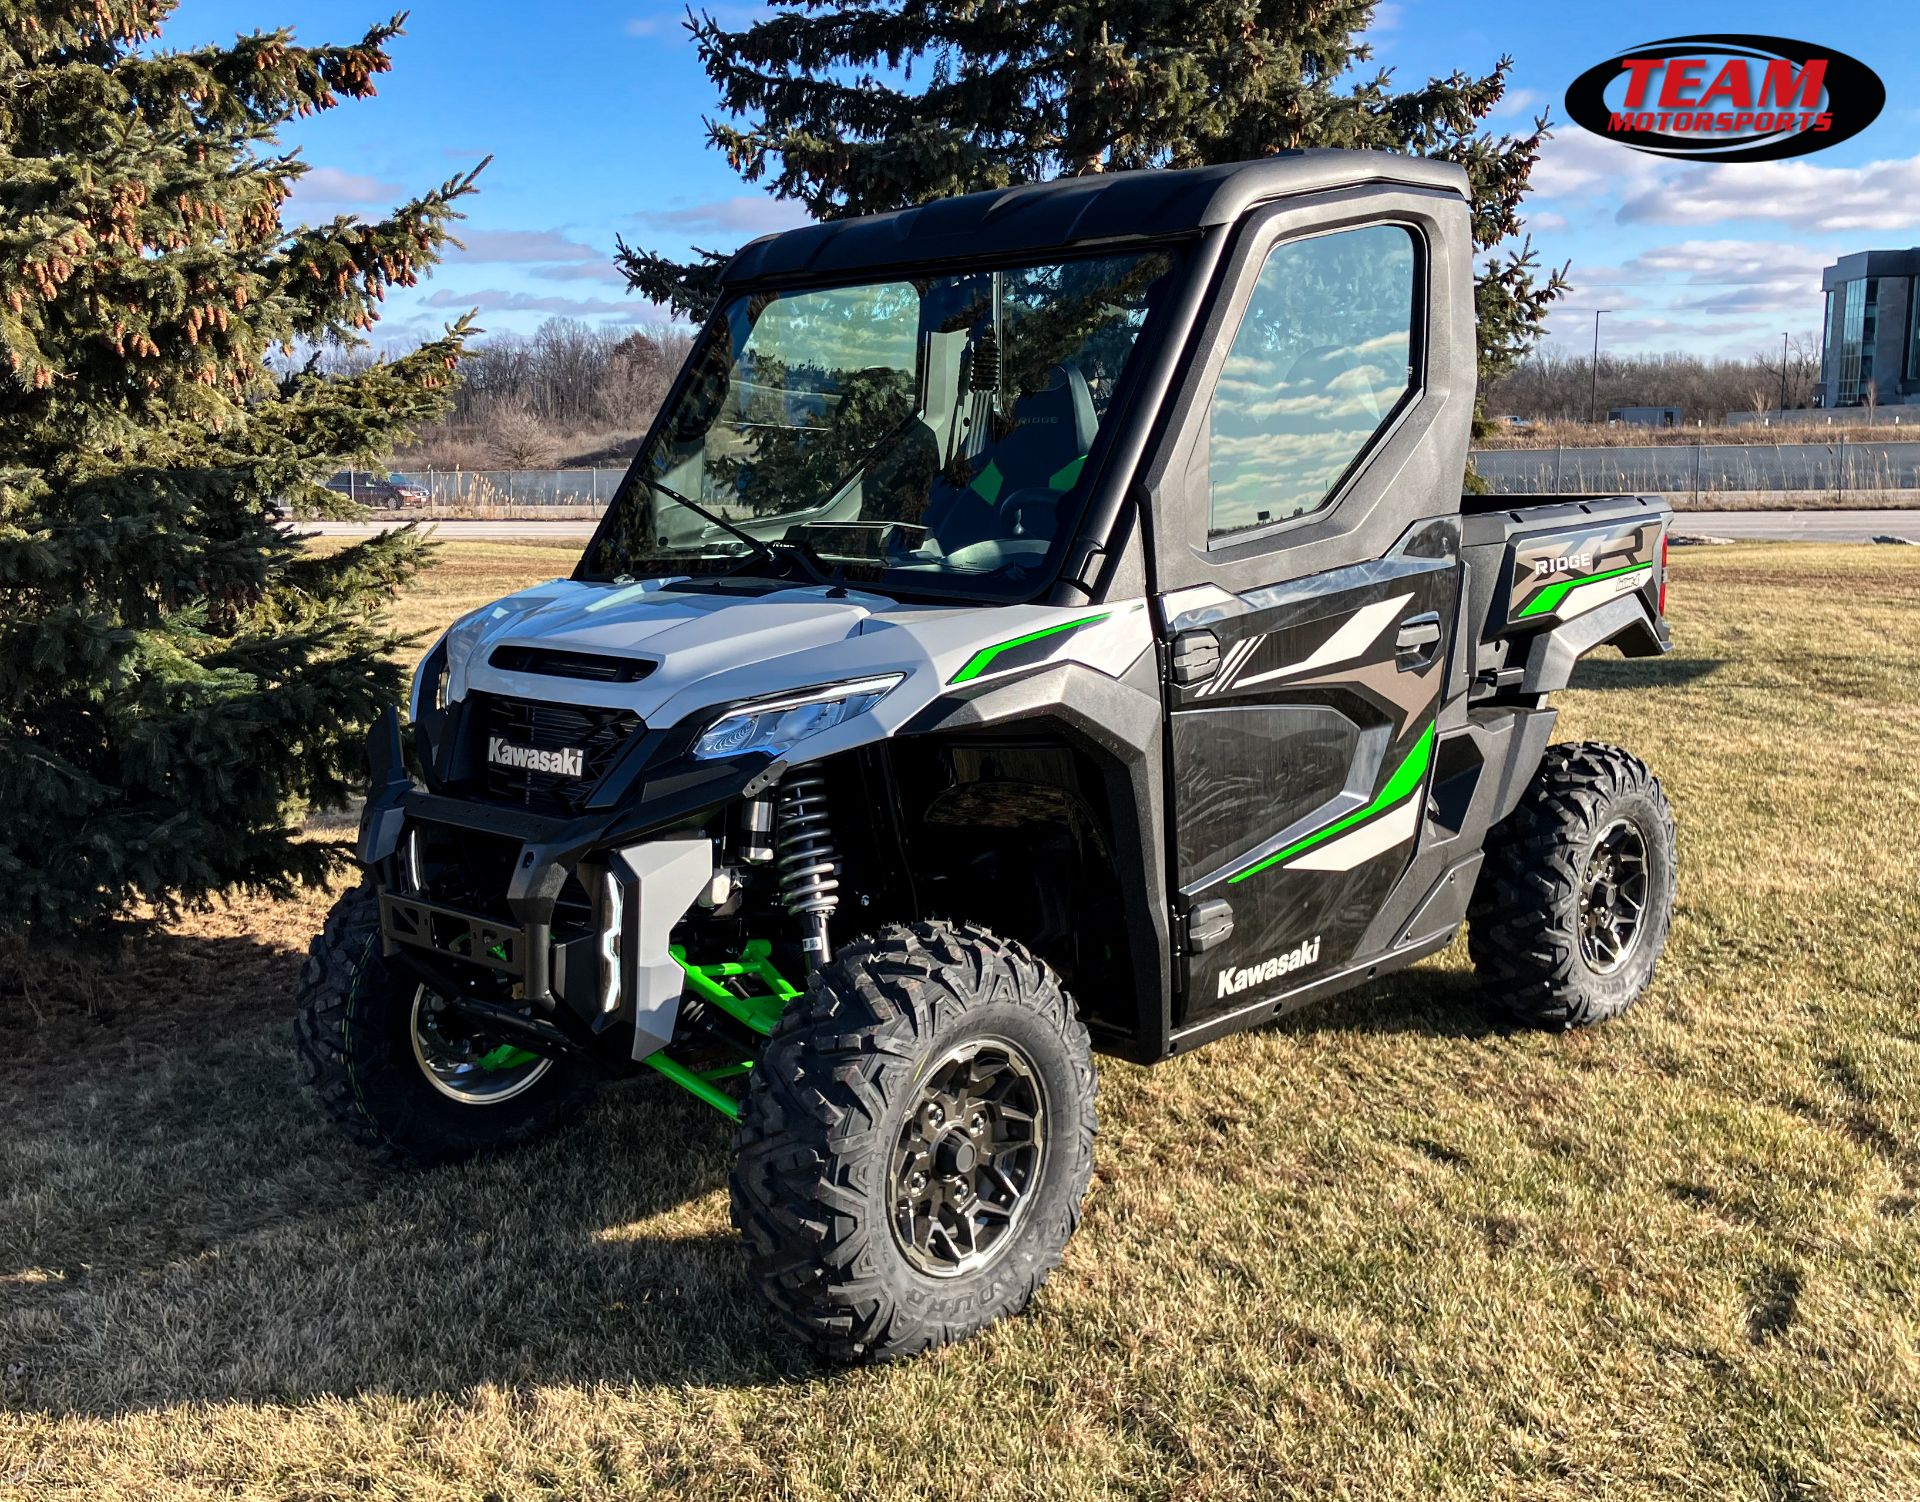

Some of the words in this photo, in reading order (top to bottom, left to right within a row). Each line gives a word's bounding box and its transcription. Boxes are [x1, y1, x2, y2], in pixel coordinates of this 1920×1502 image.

[1535, 553, 1591, 575] RIDGE
[488, 737, 584, 777] Kawasaki
[1217, 935, 1321, 999] Kawasaki
